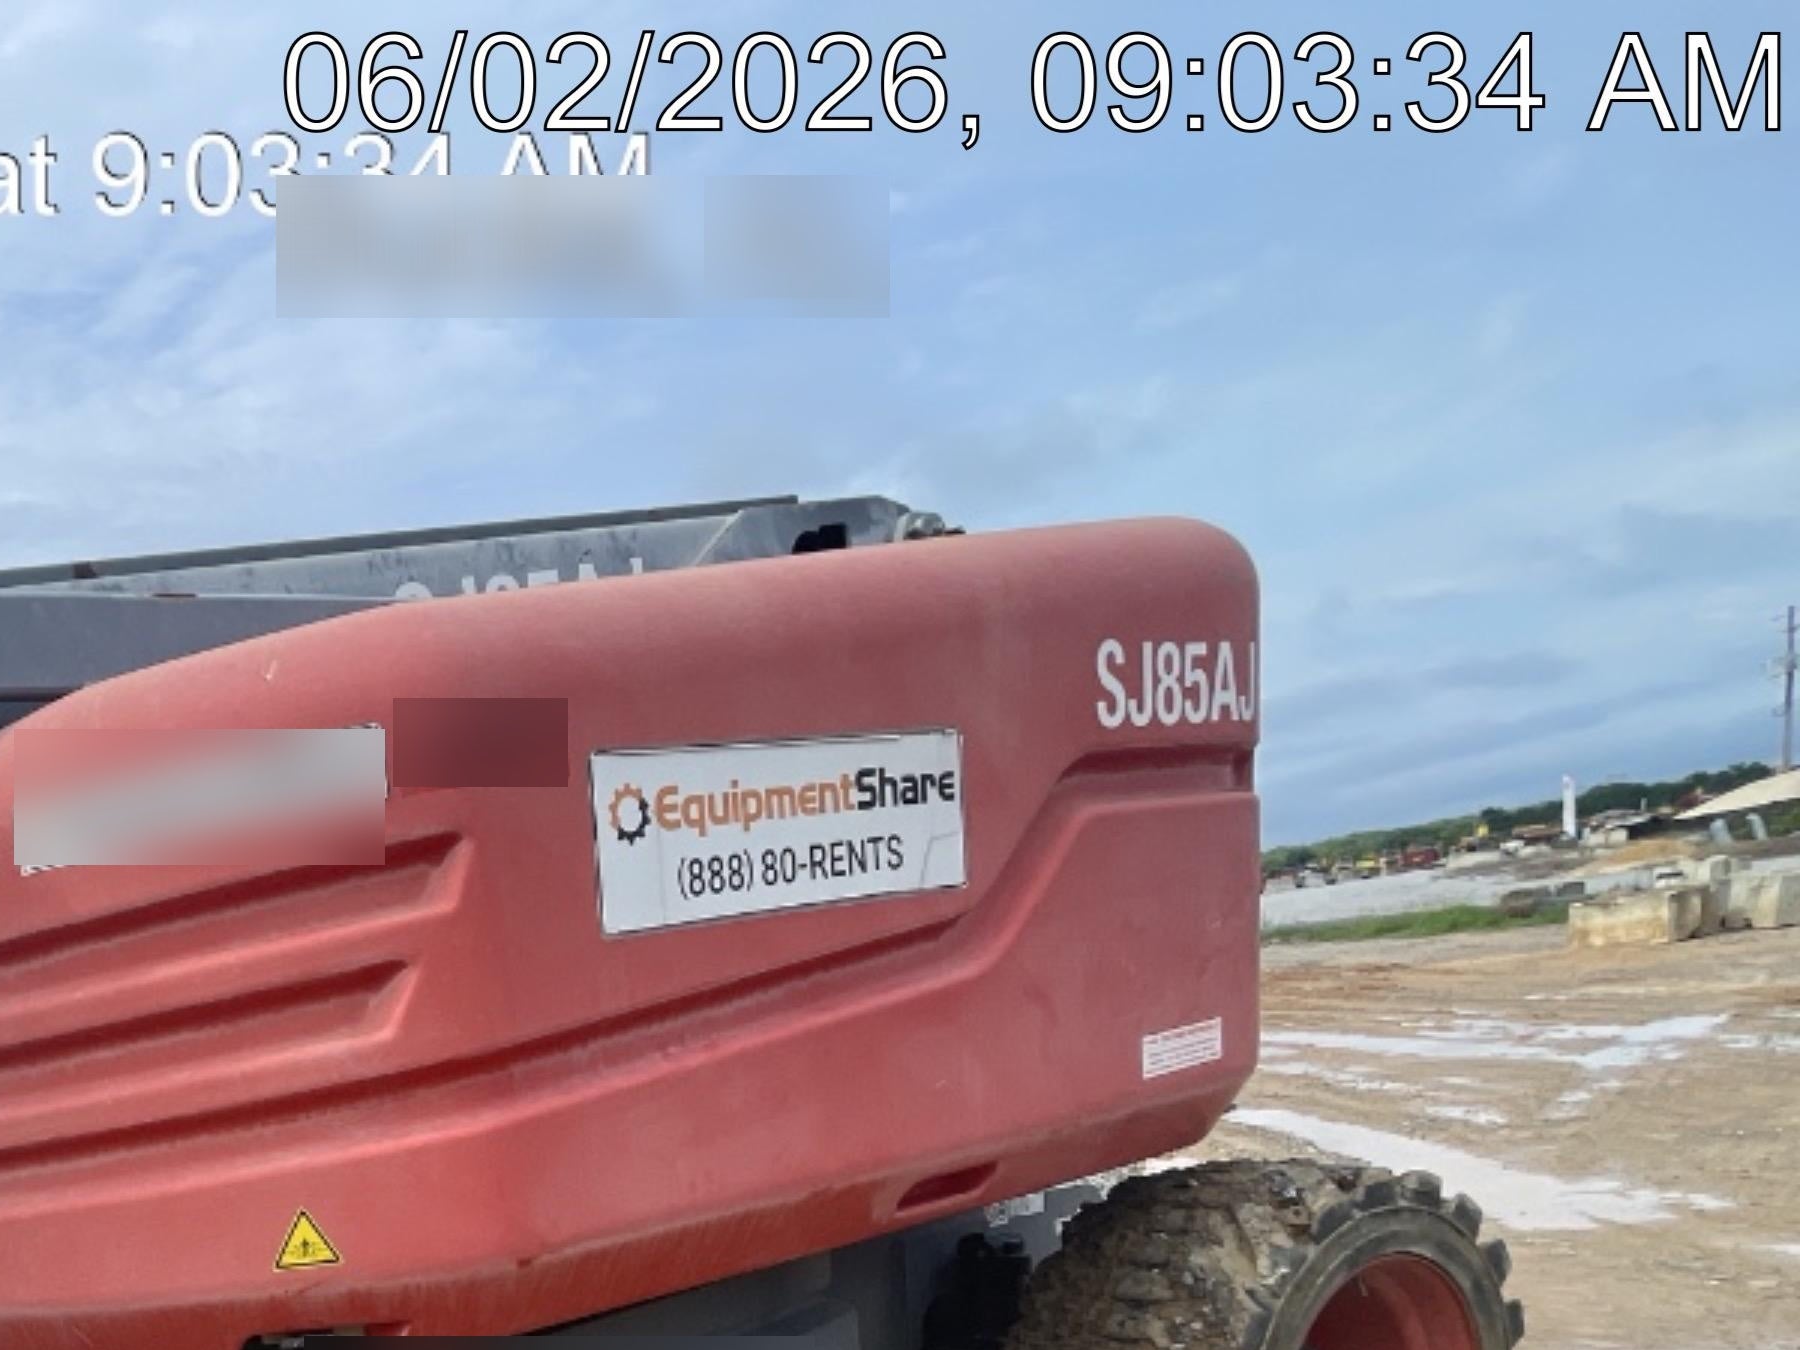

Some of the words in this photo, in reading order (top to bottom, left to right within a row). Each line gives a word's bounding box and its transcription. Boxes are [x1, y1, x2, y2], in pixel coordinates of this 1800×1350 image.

[1096, 637, 1257, 729] SJ85AJ
[654, 768, 956, 837] EquipmentShare
[677, 849, 754, 900] (888)
[761, 834, 904, 888] 80-RENTS
